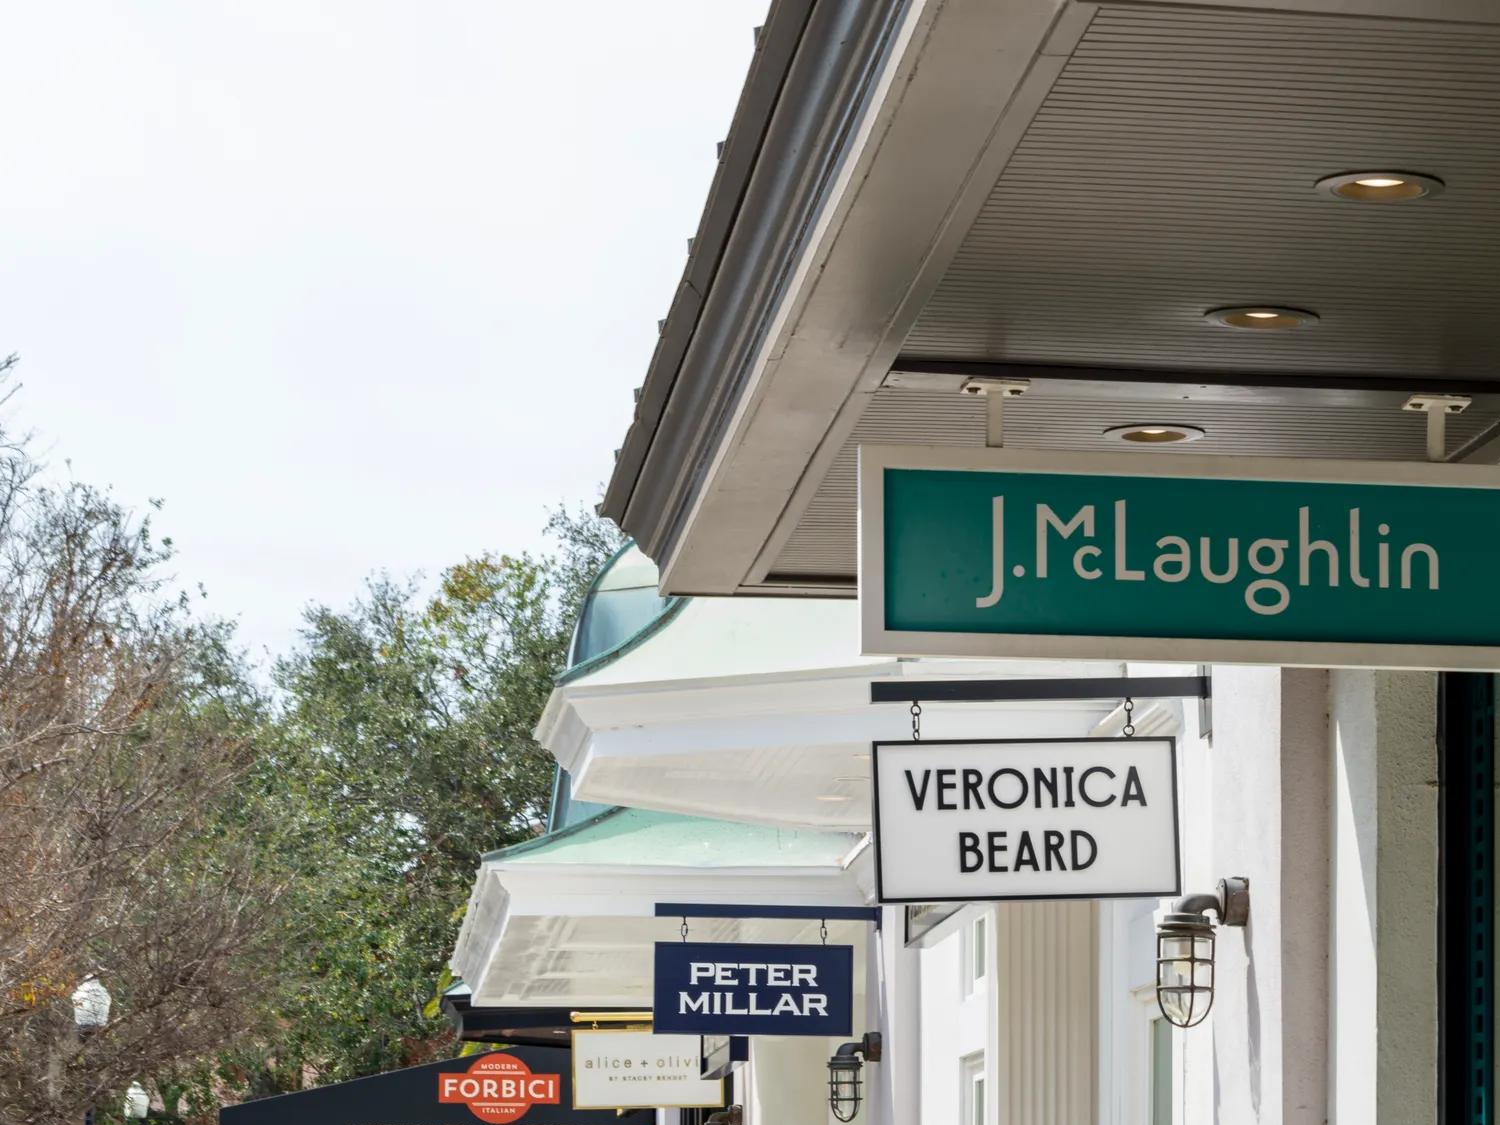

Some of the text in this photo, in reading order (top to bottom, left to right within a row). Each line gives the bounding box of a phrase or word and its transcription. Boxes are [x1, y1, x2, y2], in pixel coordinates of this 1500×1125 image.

[975, 495, 1440, 616] J.McLaughlin
[904, 765, 1148, 811] VERONICA
[958, 829, 1099, 874] BEARD
[689, 962, 818, 987] PETER
[678, 991, 828, 1017] MILLAR
[481, 1063, 518, 1071] MODERN
[585, 1056, 632, 1069] alice
[656, 1056, 699, 1068] olivi
[444, 1079, 554, 1099] FORBICI
[482, 1107, 516, 1115] ITALIAN
